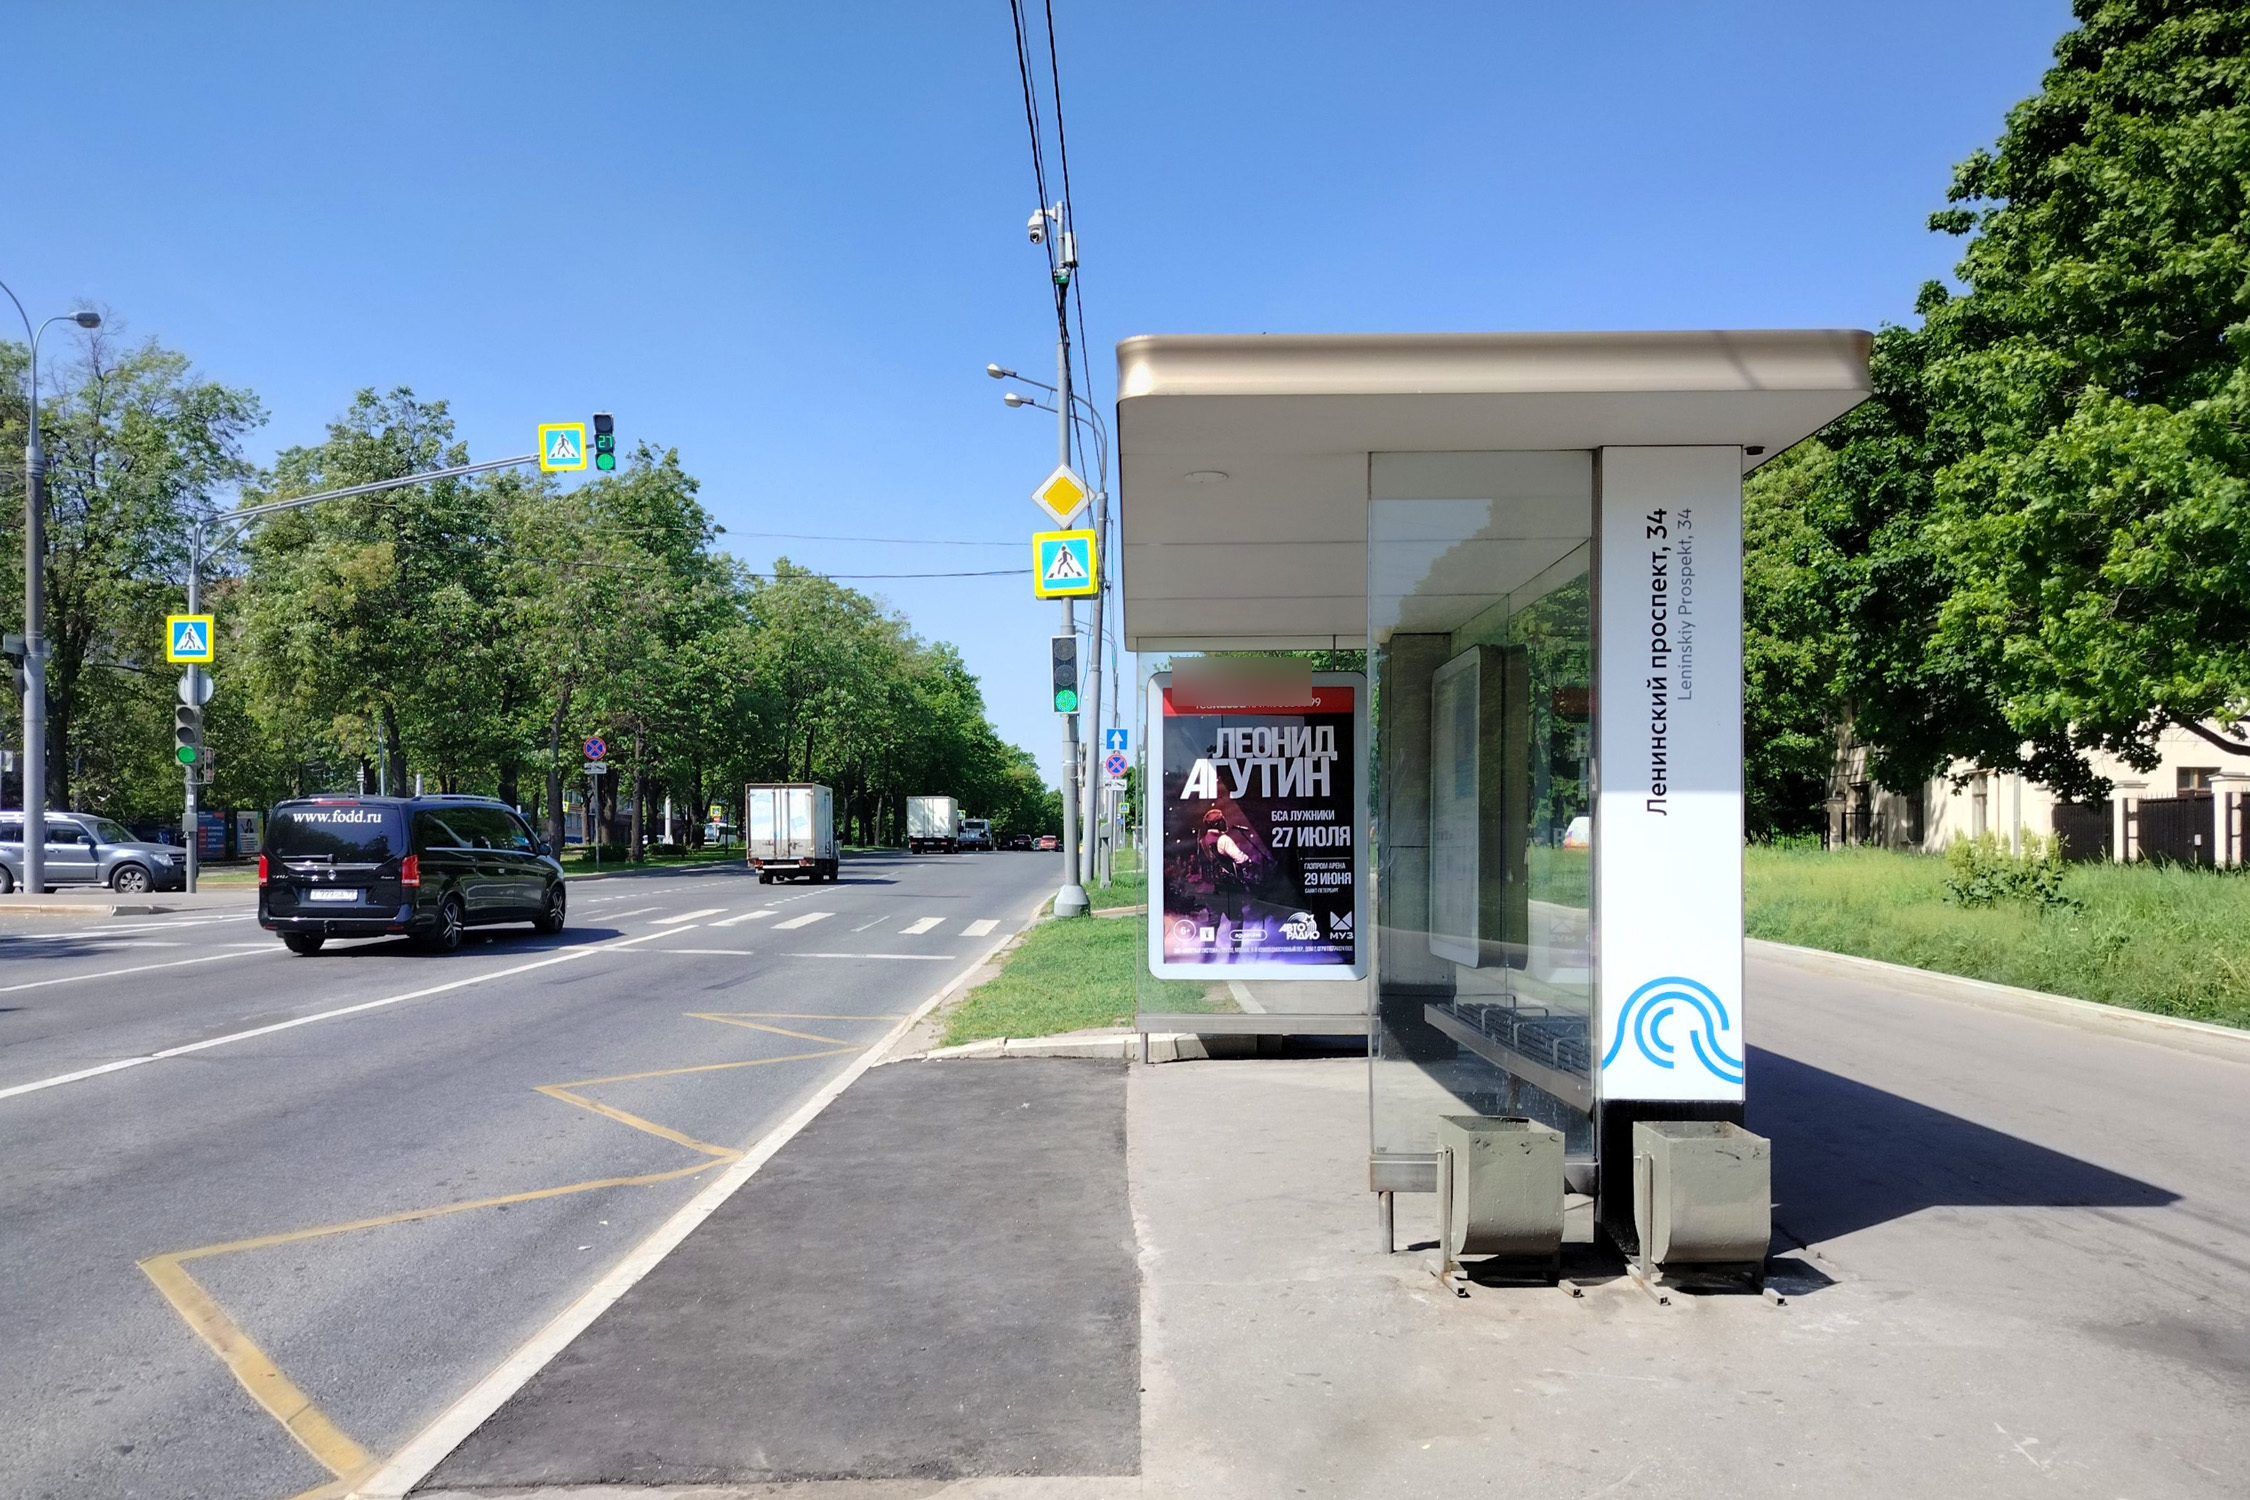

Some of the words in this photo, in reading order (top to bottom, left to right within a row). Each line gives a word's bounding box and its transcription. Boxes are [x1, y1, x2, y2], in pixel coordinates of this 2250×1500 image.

[598, 435, 612, 448] 27
[1646, 508, 1667, 539] 34
[1677, 508, 1692, 530] 34
[1676, 535, 1695, 615] Prospekt,
[1651, 546, 1672, 668] проспект,
[1677, 620, 1696, 700] Leninskiy
[1212, 725, 1338, 760] ЛЕОНИД
[1646, 677, 1667, 816] Ленинский
[1180, 757, 1331, 800] АГУТИН
[292, 810, 382, 823] www.fodd.ru
[1271, 810, 1289, 821] БСА
[1290, 810, 1335, 821] ЛУЖНИКИ
[1271, 826, 1294, 848] 27
[1297, 826, 1351, 847] ИЮЛЯ
[1303, 862, 1329, 870] ГАЗПРОМ
[1304, 872, 1318, 886] 29
[1320, 872, 1352, 885] ИЮНЯ
[1278, 923, 1306, 933] АВТО
[1286, 931, 1320, 940] РАДИО
[1329, 932, 1354, 940] МУЗ
